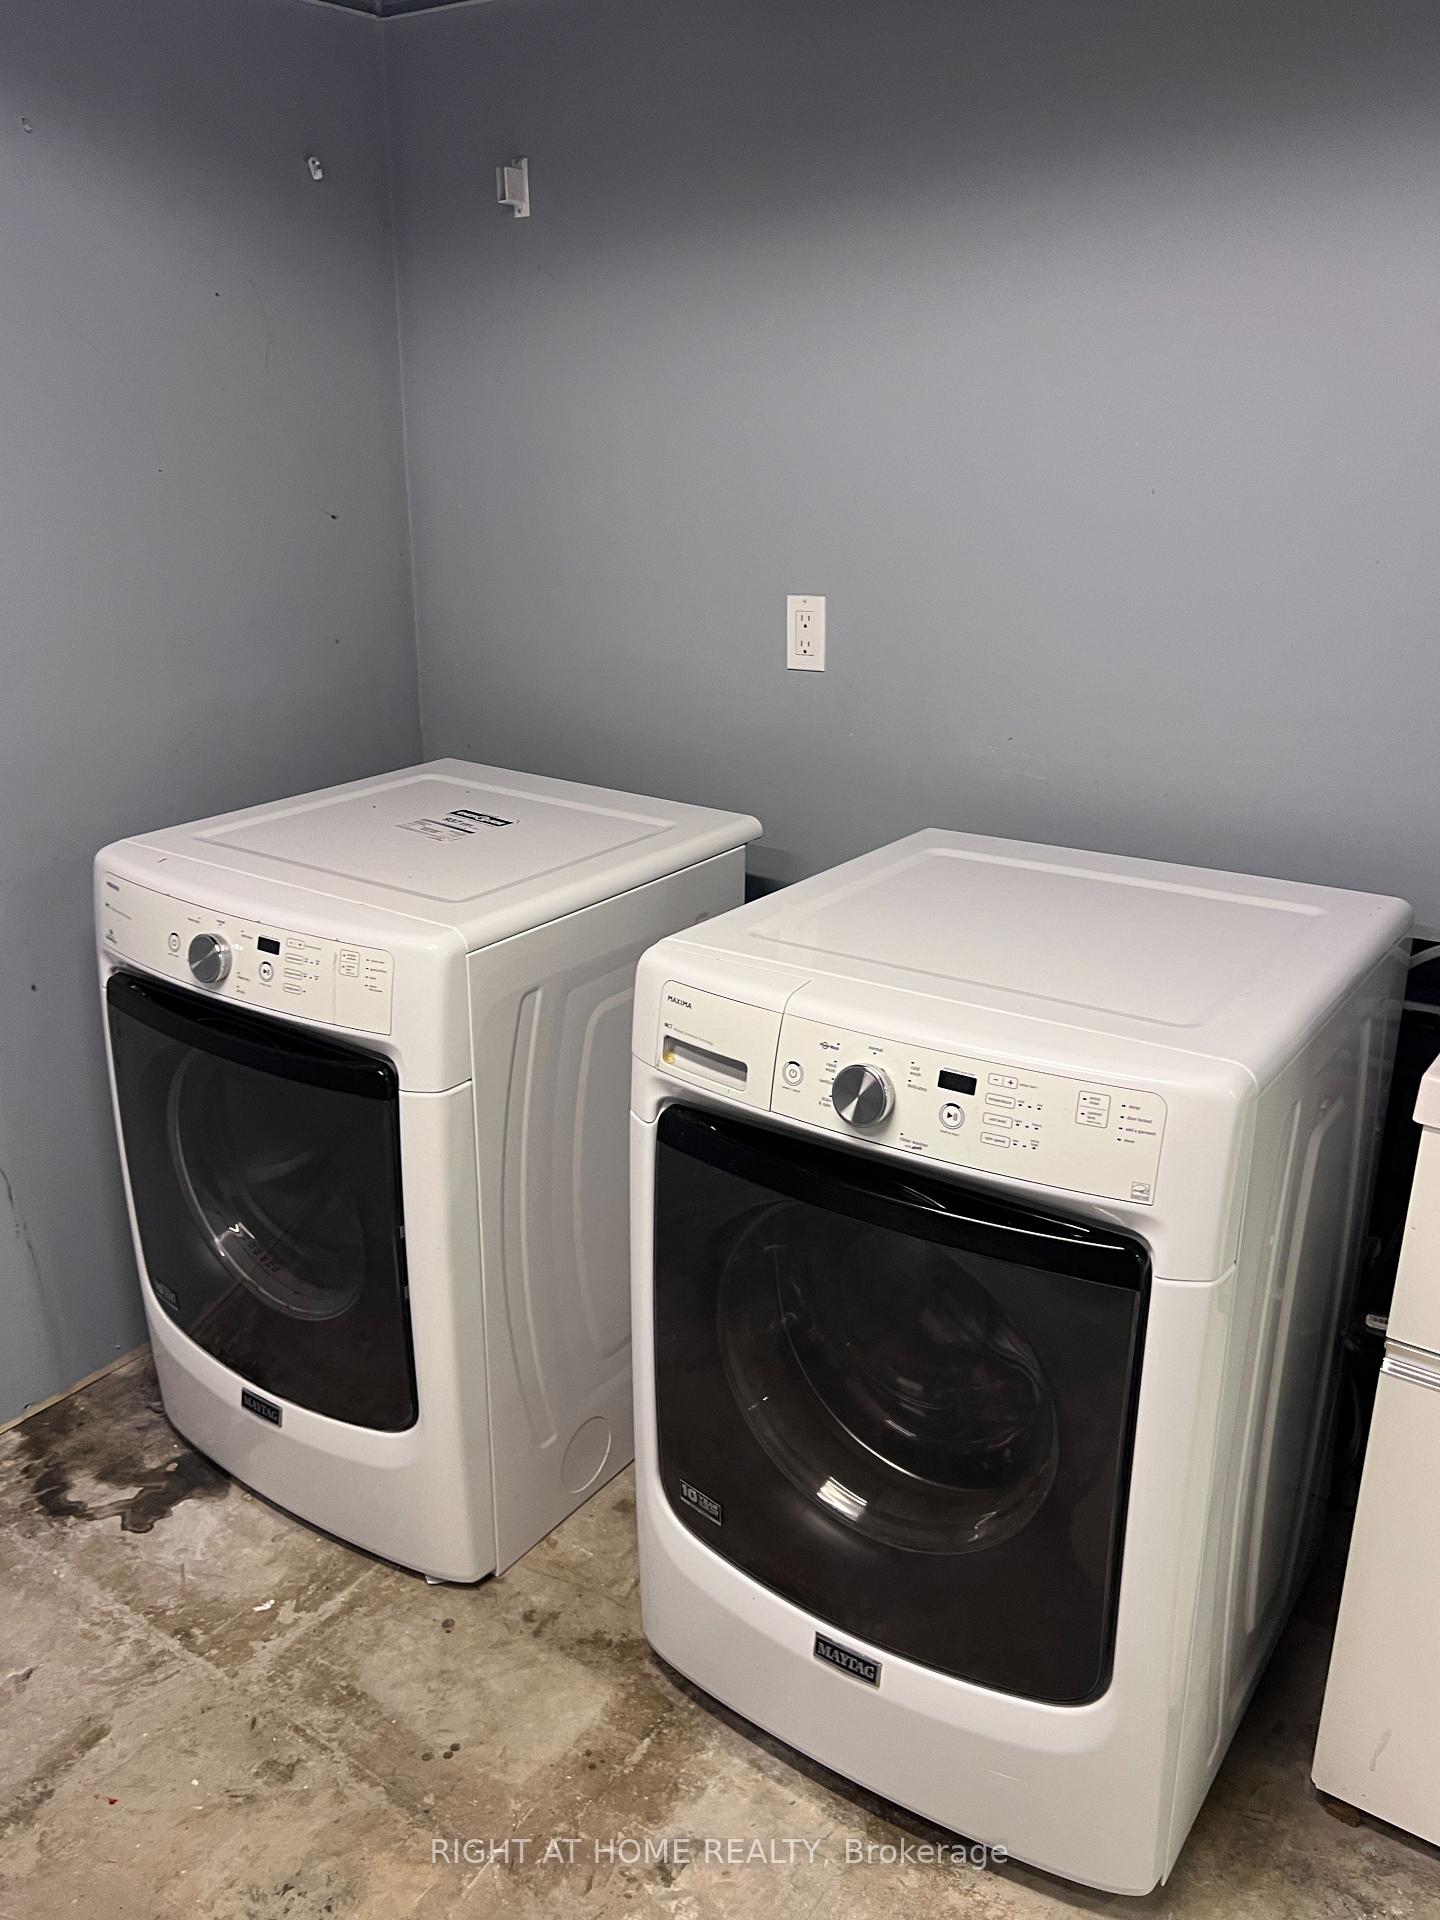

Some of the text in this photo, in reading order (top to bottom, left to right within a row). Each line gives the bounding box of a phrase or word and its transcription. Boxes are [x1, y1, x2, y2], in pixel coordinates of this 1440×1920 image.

[667, 994, 693, 1010] MAXIMA
[243, 1394, 278, 1421] MAYTAG
[681, 1483, 698, 1503] 10
[817, 1641, 875, 1680] MAYTAG
